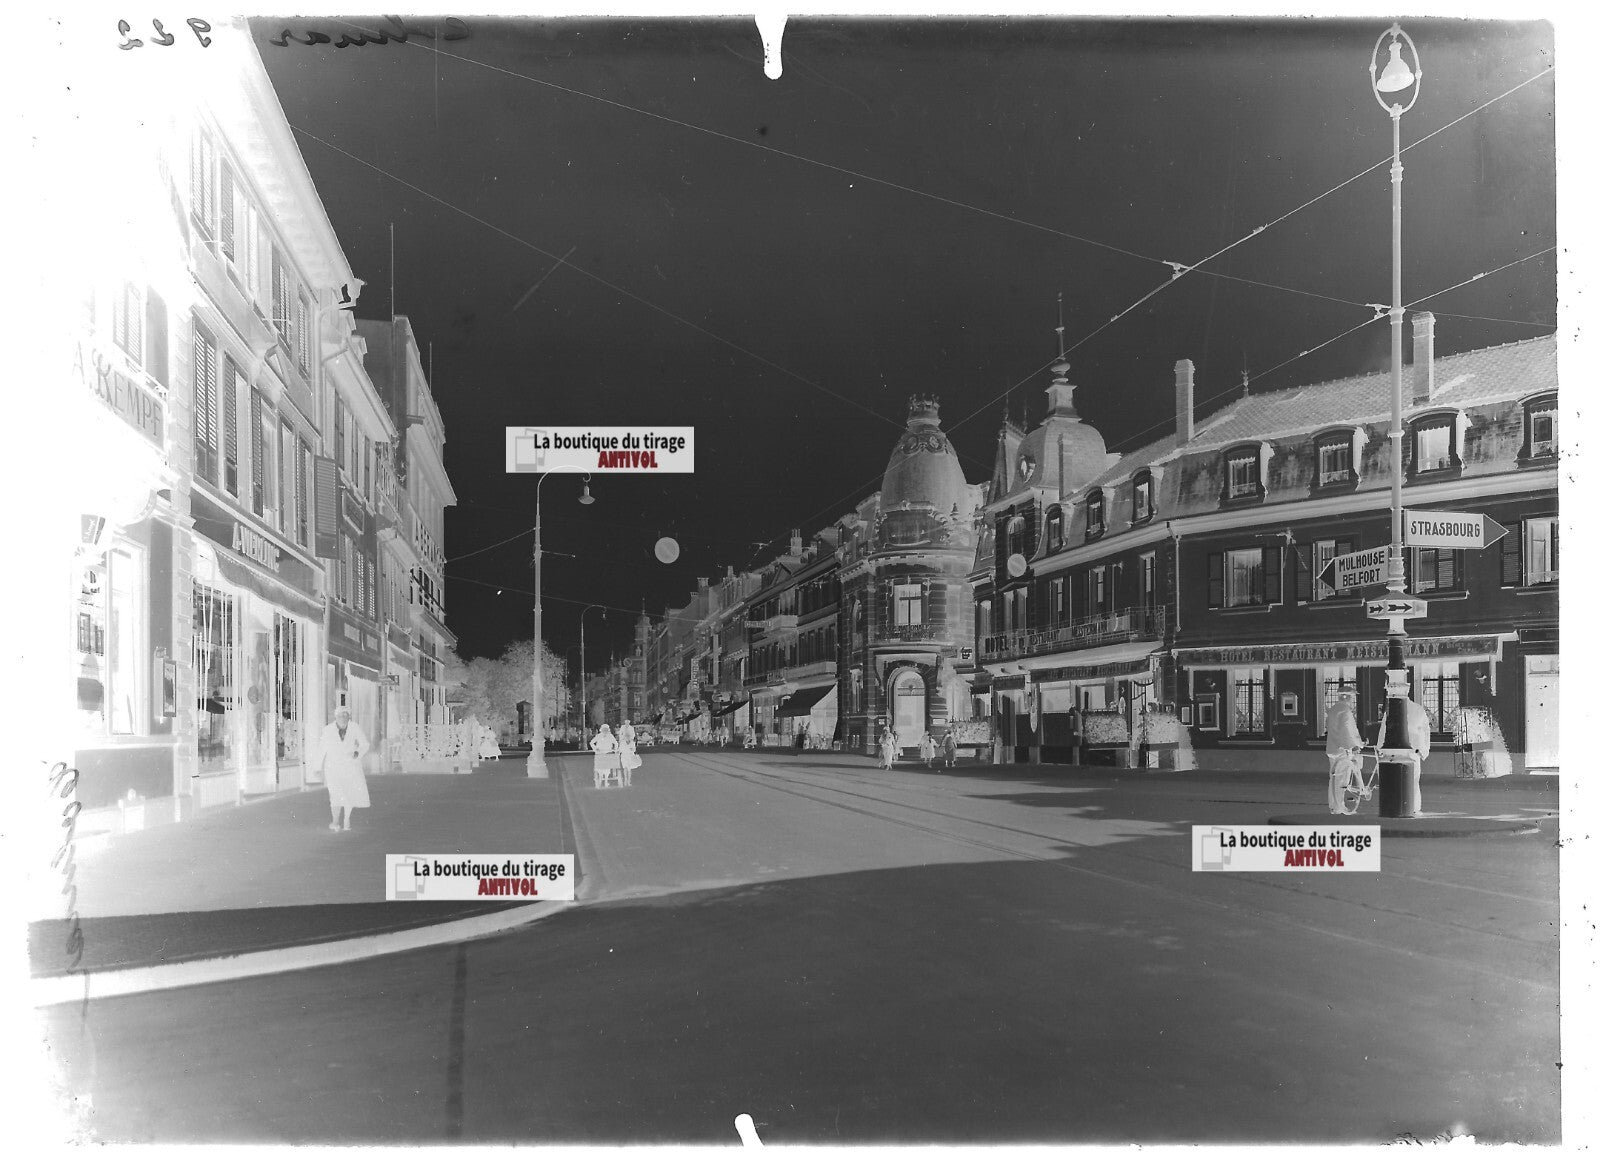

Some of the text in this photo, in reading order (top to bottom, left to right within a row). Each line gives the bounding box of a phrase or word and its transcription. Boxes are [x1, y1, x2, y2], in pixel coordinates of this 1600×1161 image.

[1410, 520, 1481, 538] STRASBOURG
[1338, 550, 1385, 572] MULHOUSE
[1342, 568, 1381, 587] BELFORT
[1264, 648, 1338, 662] RESTAURANT
[1346, 642, 1440, 659] MEISTMANN
